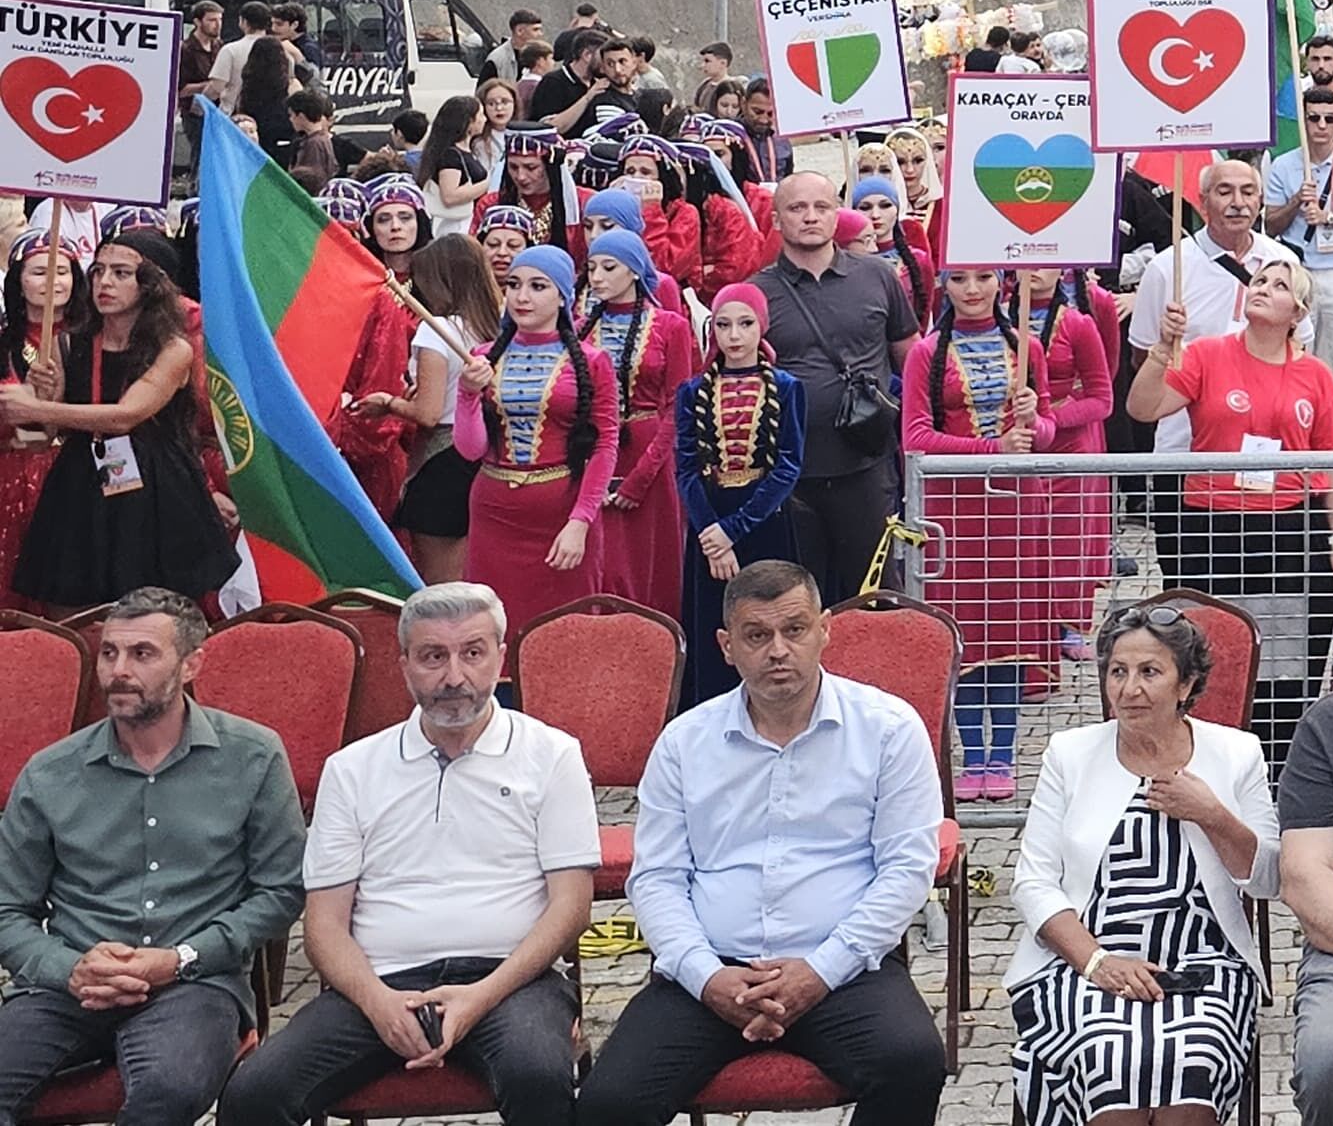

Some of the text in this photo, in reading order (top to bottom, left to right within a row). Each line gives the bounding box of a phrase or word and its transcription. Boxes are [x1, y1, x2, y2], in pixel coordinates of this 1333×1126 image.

[0, 3, 159, 50] TÜRKİYE
[323, 66, 404, 97] HAYAL
[957, 92, 1037, 110] KARAÇAY
[1055, 94, 1091, 110] ÇER
[1010, 110, 1064, 121] ORAYDA
